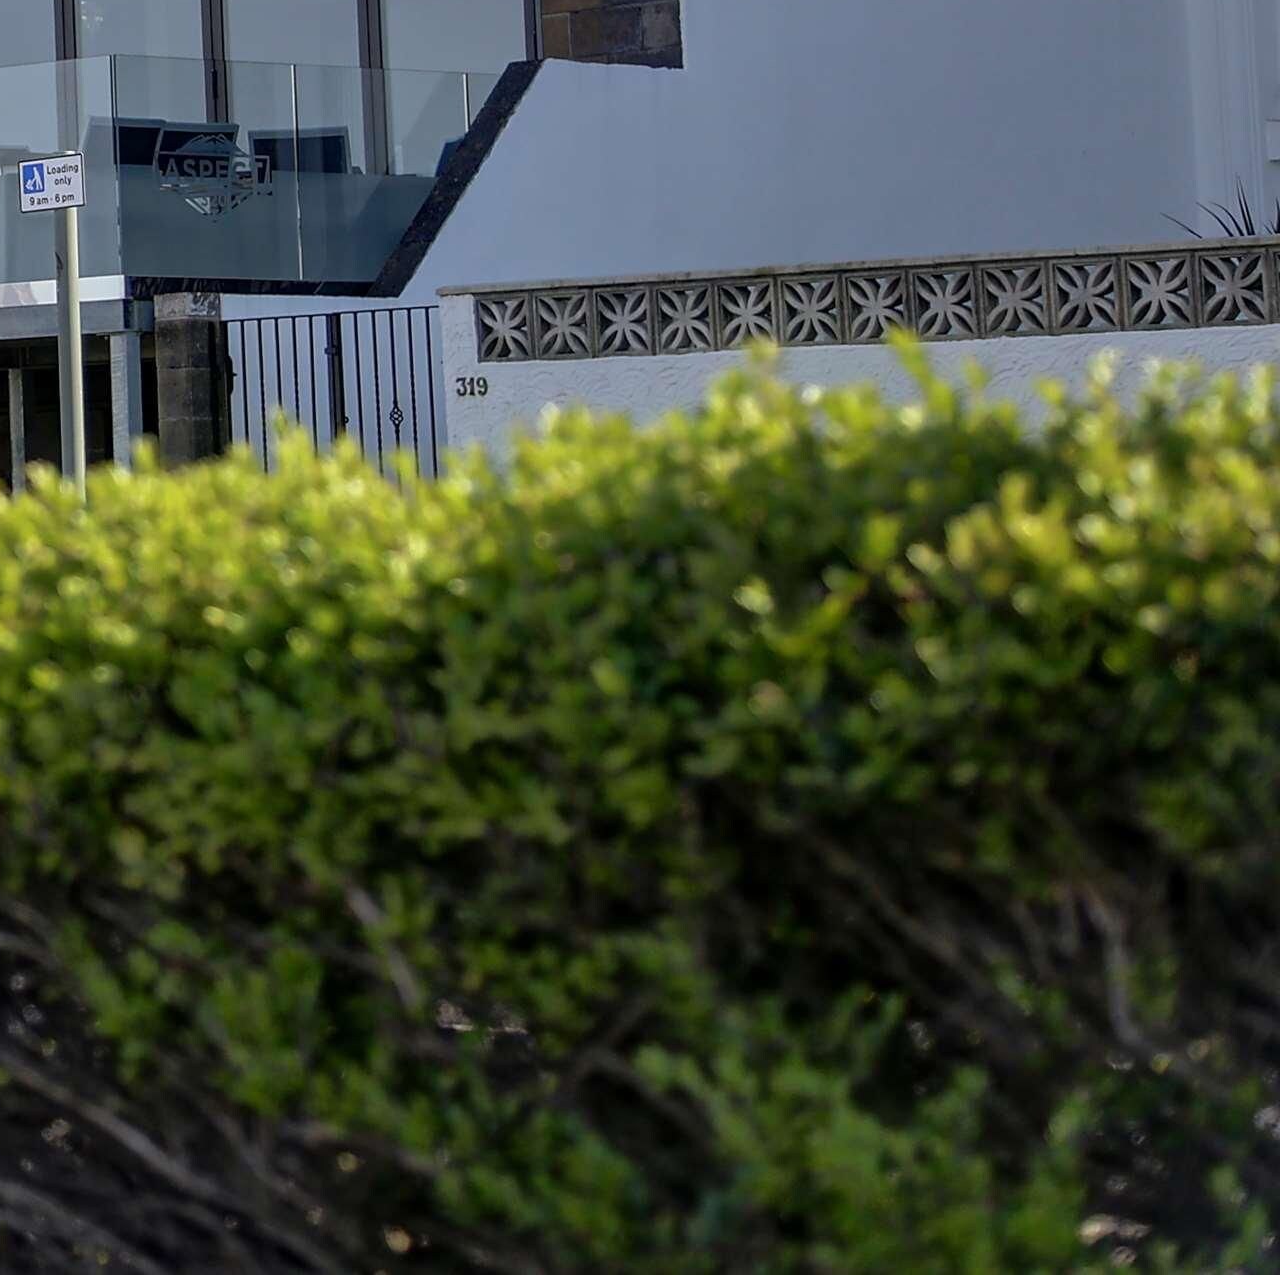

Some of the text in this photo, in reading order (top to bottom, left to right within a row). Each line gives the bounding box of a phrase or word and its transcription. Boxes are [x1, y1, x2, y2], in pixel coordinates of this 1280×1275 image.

[46, 164, 79, 175] Loading
[54, 177, 72, 186] only
[455, 376, 488, 396] 319
